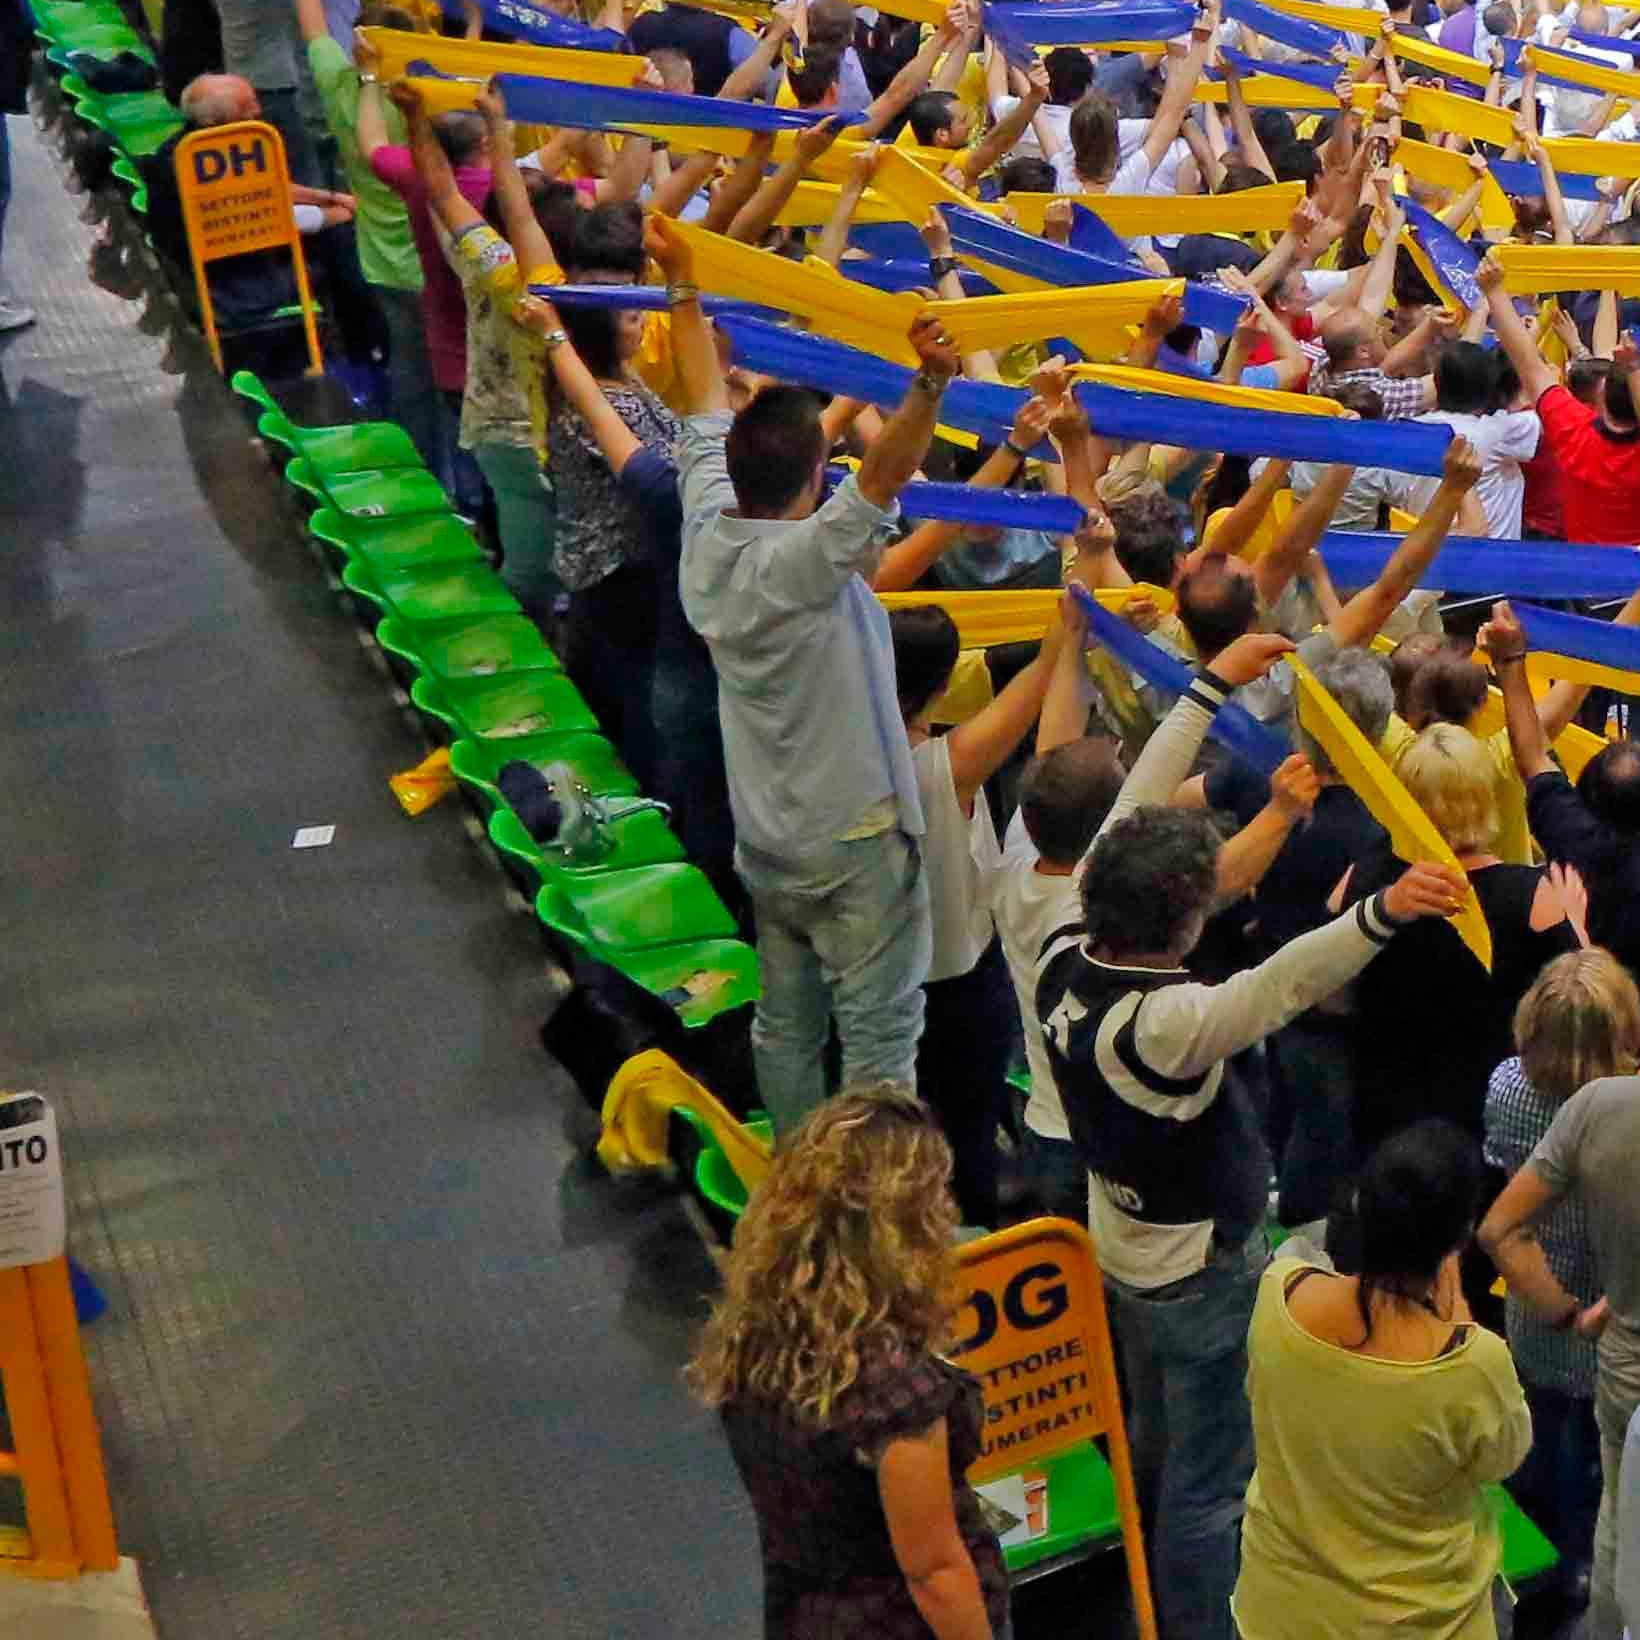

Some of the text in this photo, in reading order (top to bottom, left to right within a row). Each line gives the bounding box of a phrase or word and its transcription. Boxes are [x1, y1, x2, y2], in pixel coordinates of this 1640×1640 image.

[192, 138, 267, 185] DH
[984, 1336, 1085, 1389] TTORE
[985, 1370, 1090, 1425] STINTI
[979, 1400, 1096, 1459] UMERATI
